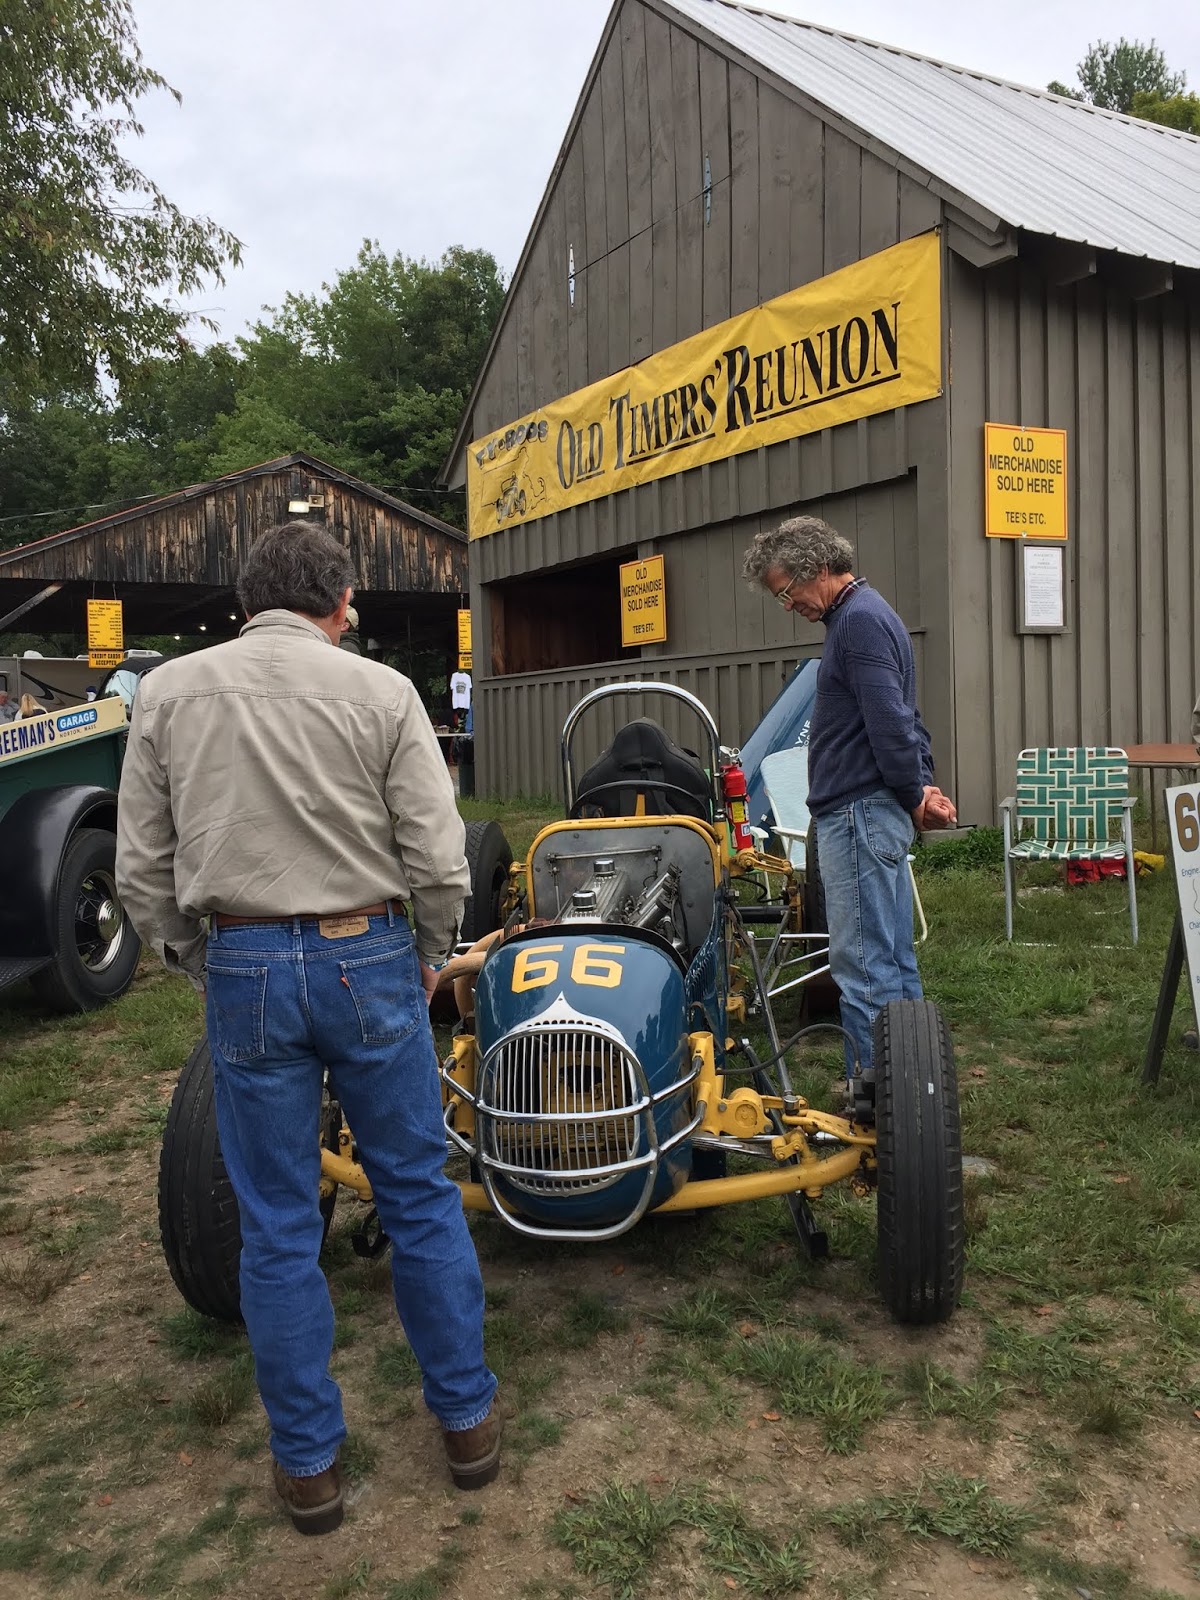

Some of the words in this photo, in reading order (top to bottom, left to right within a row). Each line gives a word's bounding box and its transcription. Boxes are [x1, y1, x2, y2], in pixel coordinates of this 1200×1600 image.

[556, 419, 604, 490] OLD
[722, 301, 901, 433] REUNION
[1013, 436, 1034, 452] OLD
[989, 454, 1063, 475] MERCHANDISE
[997, 475, 1024, 492] SOLD
[1026, 478, 1055, 494] HERE
[1005, 511, 1027, 524] TEE'S
[1028, 512, 1047, 525] ETC.
[636, 568, 647, 580] OLD
[623, 578, 663, 598] MERCHANDISE
[628, 599, 643, 612] SOLD
[644, 595, 659, 608] HERE
[59, 710, 96, 729] GARAGE
[511, 943, 626, 994] 66
